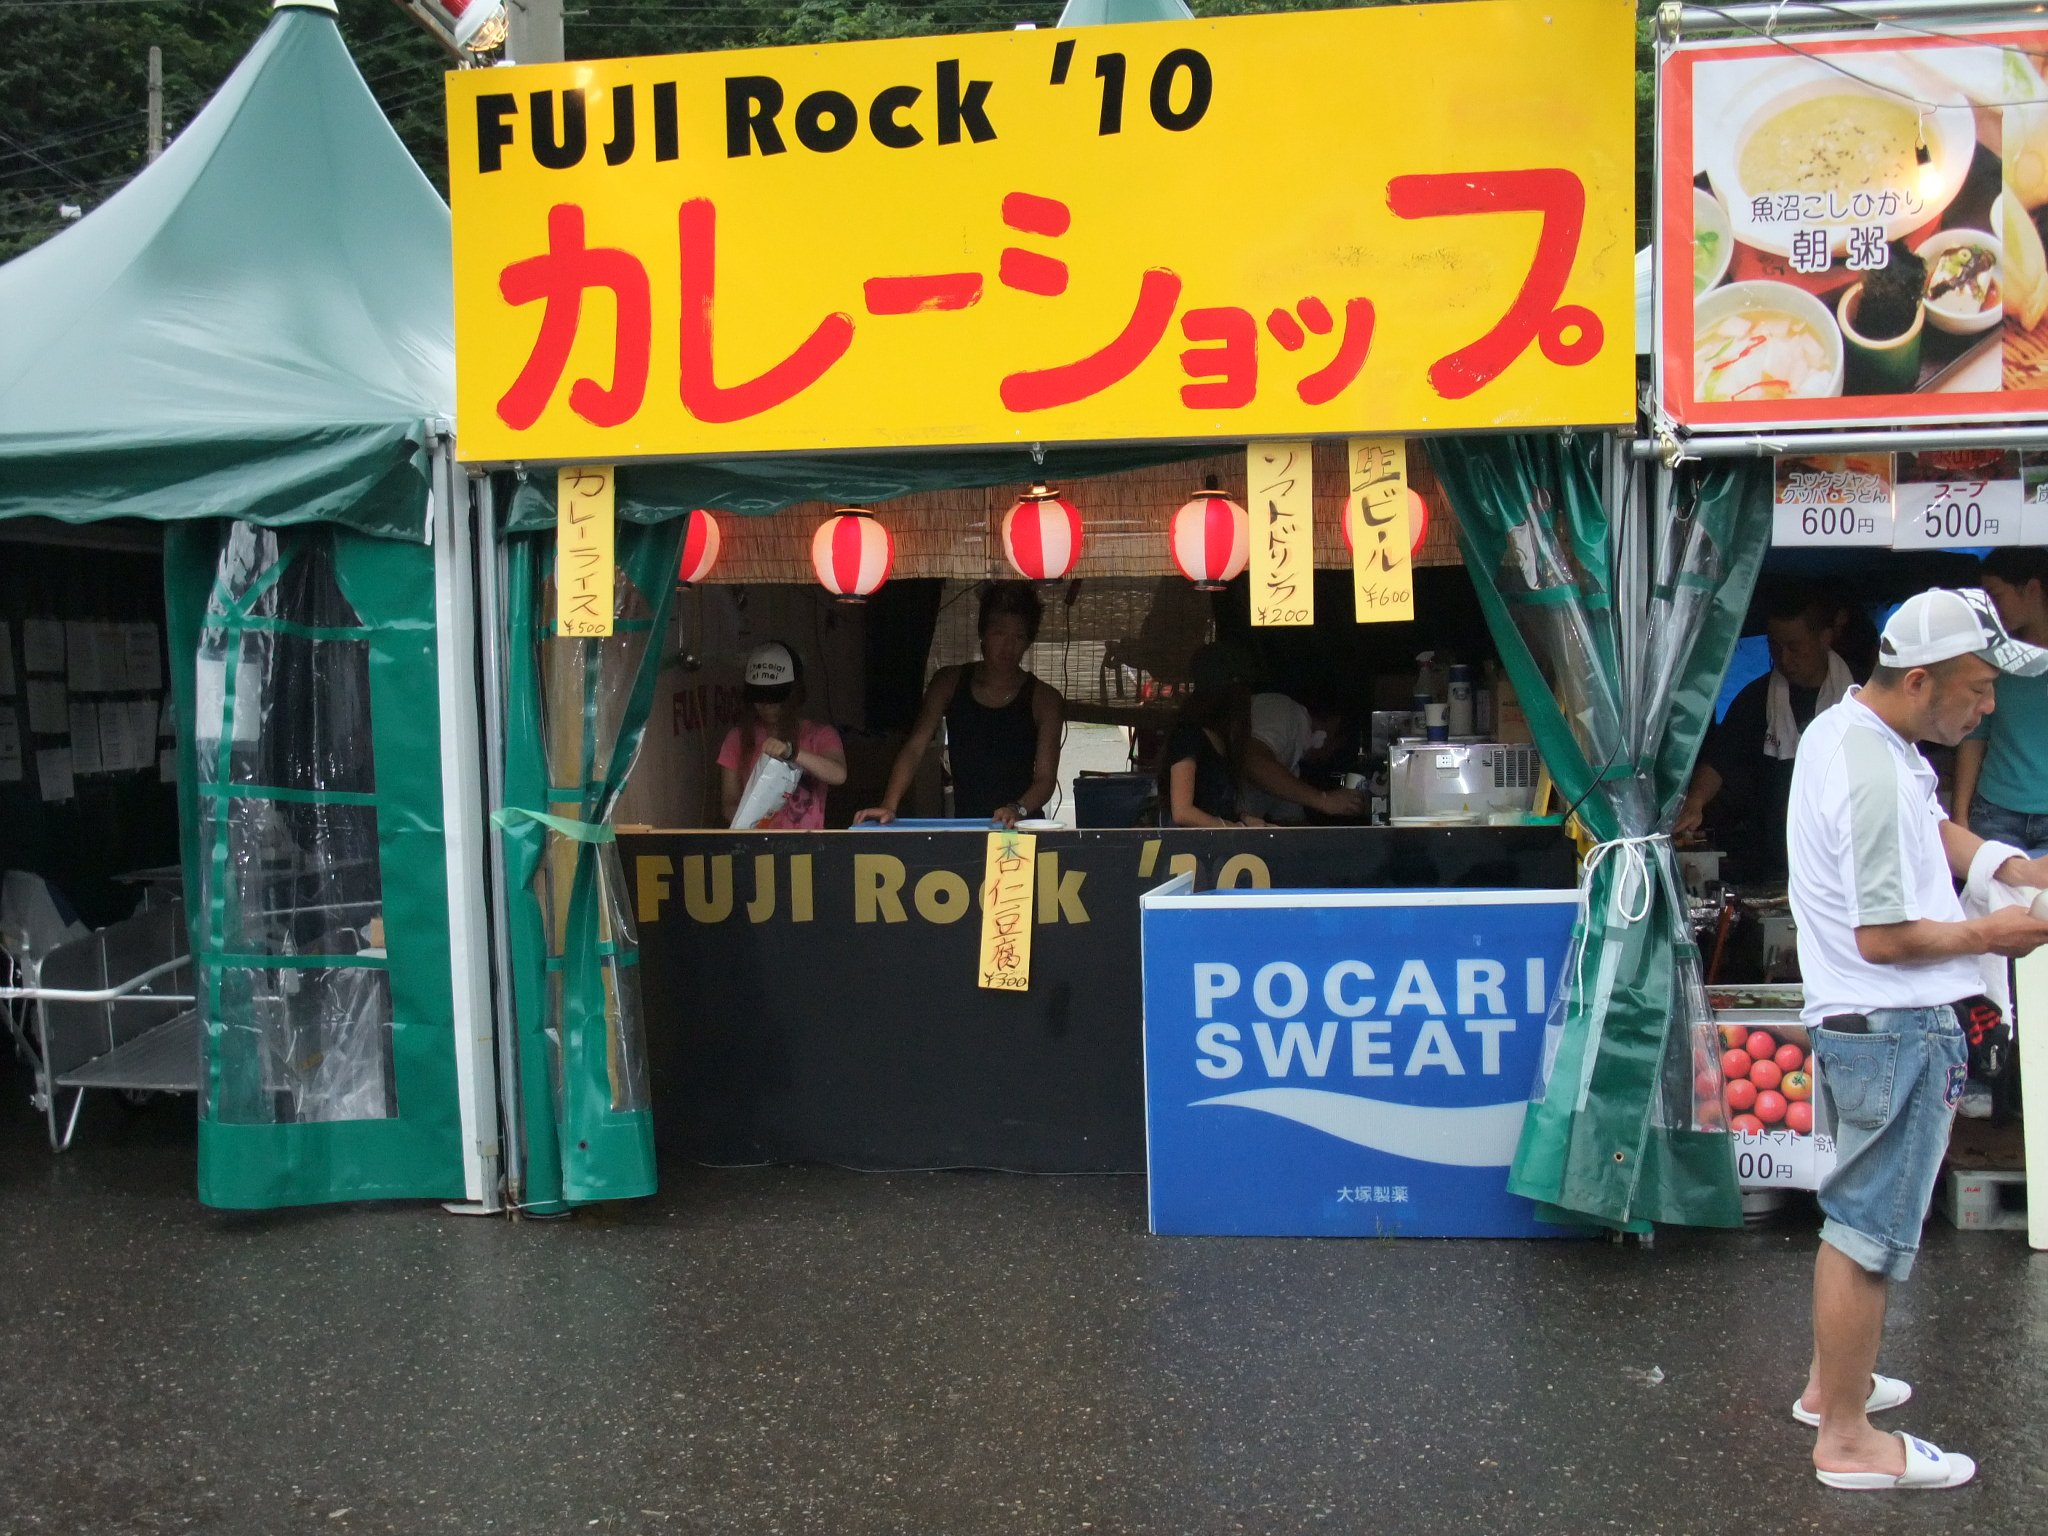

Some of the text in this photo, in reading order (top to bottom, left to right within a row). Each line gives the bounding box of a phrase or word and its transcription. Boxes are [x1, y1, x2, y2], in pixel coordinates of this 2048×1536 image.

[476, 38, 1213, 175] FUJI Rock '10
[1751, 190, 1924, 223] 魚沼こしひかり
[496, 167, 1605, 431] カレーショップ
[1934, 480, 1989, 499] スープ
[1802, 507, 1874, 535] 600円
[1925, 502, 1999, 538] 500円
[564, 469, 605, 616] カレーライス
[1362, 583, 1410, 608] ¥600
[564, 620, 606, 635] ¥500
[1258, 608, 1309, 625] ¥200
[636, 853, 814, 924] FUJI
[854, 851, 1091, 924] Rok
[988, 840, 1031, 971] 杏仁豆腐
[984, 970, 1028, 989] ¥300
[1193, 957, 1546, 1018] POCARI
[1195, 1018, 1517, 1079] SWEAT
[1336, 1185, 1410, 1204] 大塚製薬
